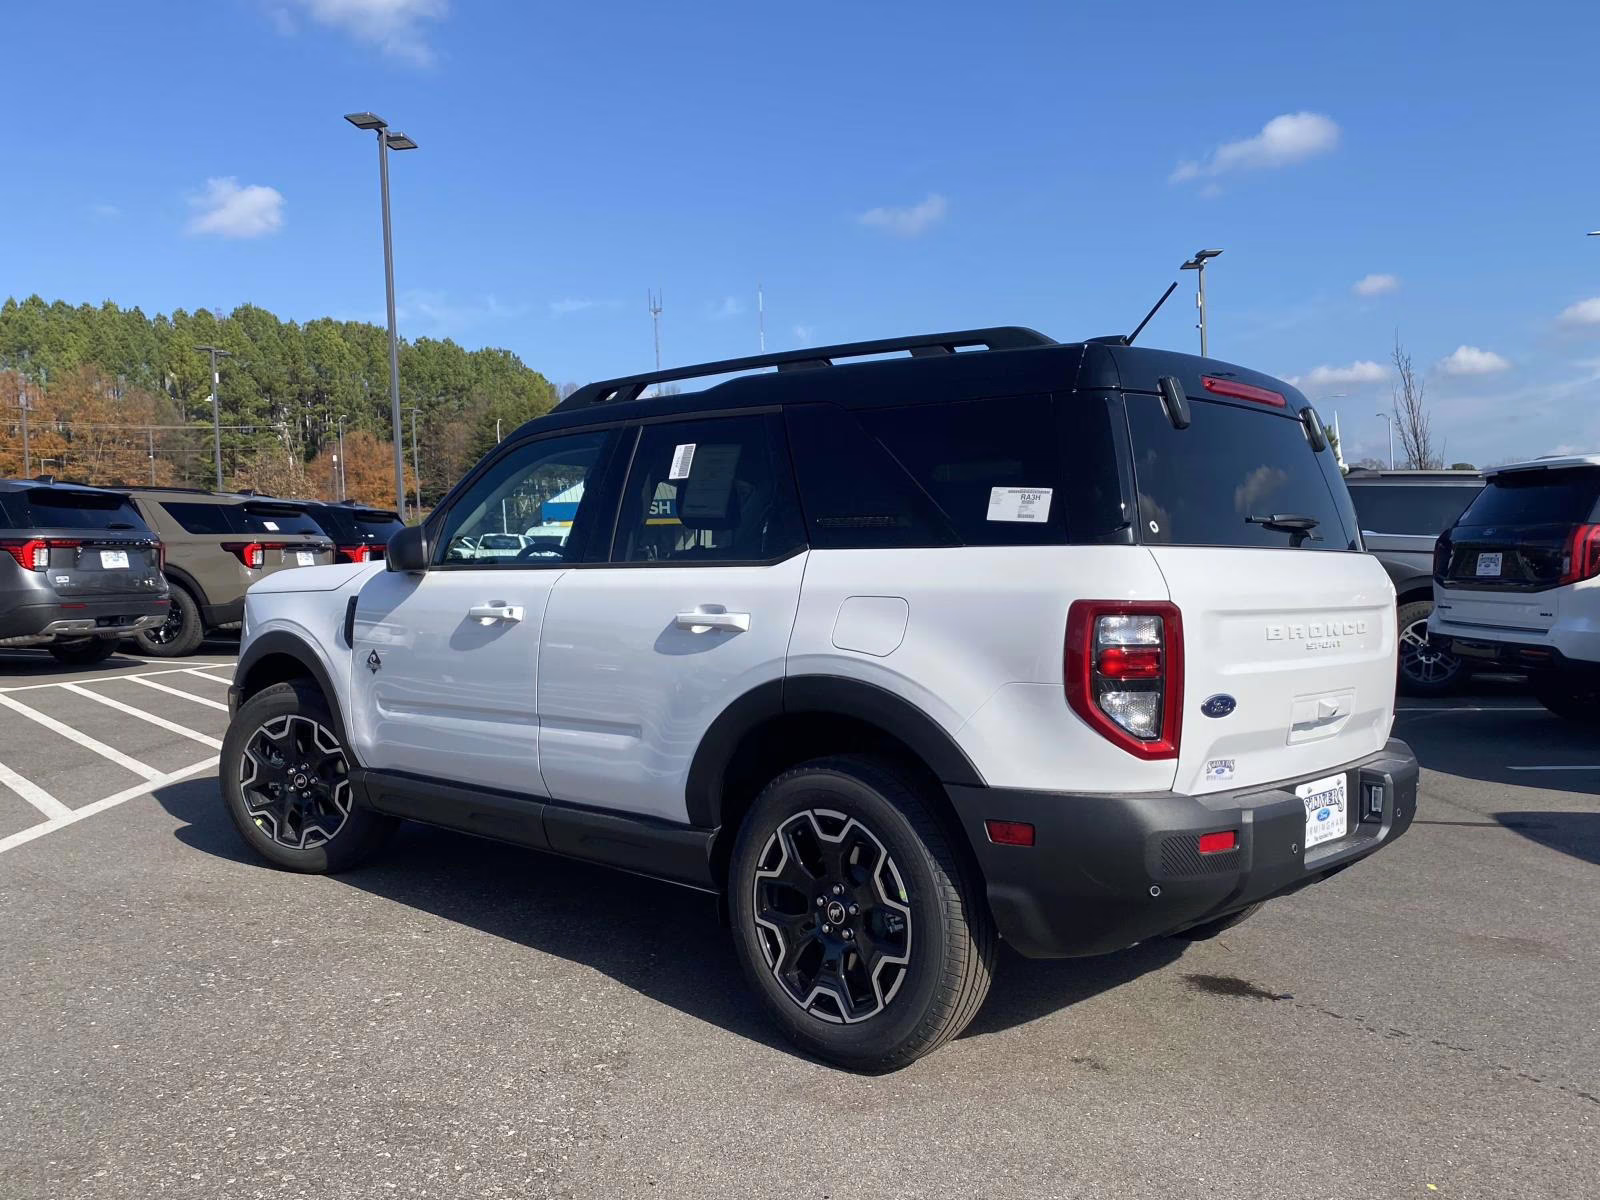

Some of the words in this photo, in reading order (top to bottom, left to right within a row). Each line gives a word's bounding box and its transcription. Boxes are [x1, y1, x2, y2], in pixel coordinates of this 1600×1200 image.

[1265, 622, 1367, 640] BRONCO
[1305, 640, 1341, 650] SPORT
[1303, 786, 1344, 824] STIVERS
[1306, 816, 1344, 836] IRMINGHAM
